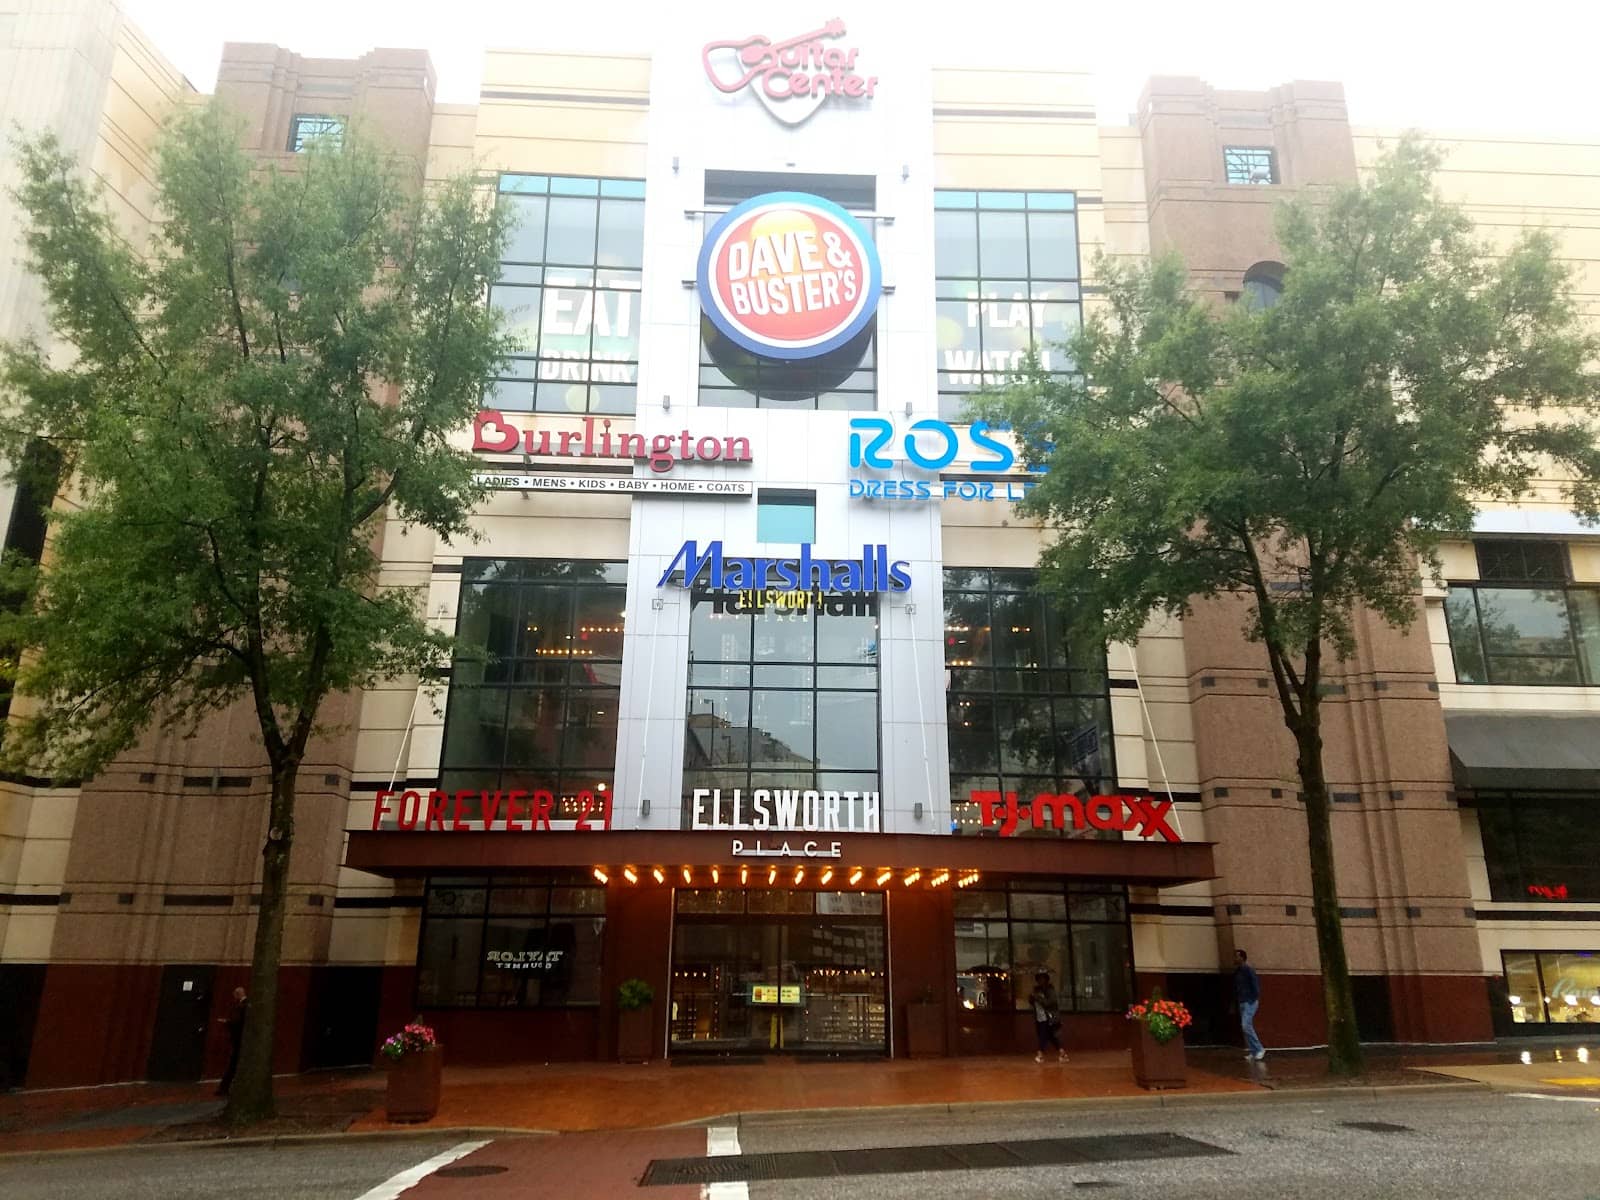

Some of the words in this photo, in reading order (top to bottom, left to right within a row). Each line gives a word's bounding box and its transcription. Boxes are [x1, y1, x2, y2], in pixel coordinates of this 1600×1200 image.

[762, 65, 878, 100] Center
[728, 231, 824, 281] DAVE
[823, 231, 853, 269] &
[544, 276, 641, 337] EAT
[730, 268, 857, 316] BUSTER'S
[967, 291, 1049, 328] PLAY
[540, 348, 633, 383] DRINK
[472, 409, 753, 473] Burlington
[476, 476, 520, 487] LADIES
[532, 477, 567, 488] MENS
[578, 478, 607, 489] KIDS
[618, 480, 650, 490] BABY
[660, 481, 696, 492] HOME
[706, 482, 746, 493] COATS
[850, 479, 931, 501] DRESS
[943, 480, 995, 502] FOR
[656, 540, 912, 593] Marshalls
[372, 789, 554, 832] FOREVER
[575, 789, 614, 832] 21
[691, 788, 882, 834] ELLSWORTH
[731, 840, 842, 858] PLACE
